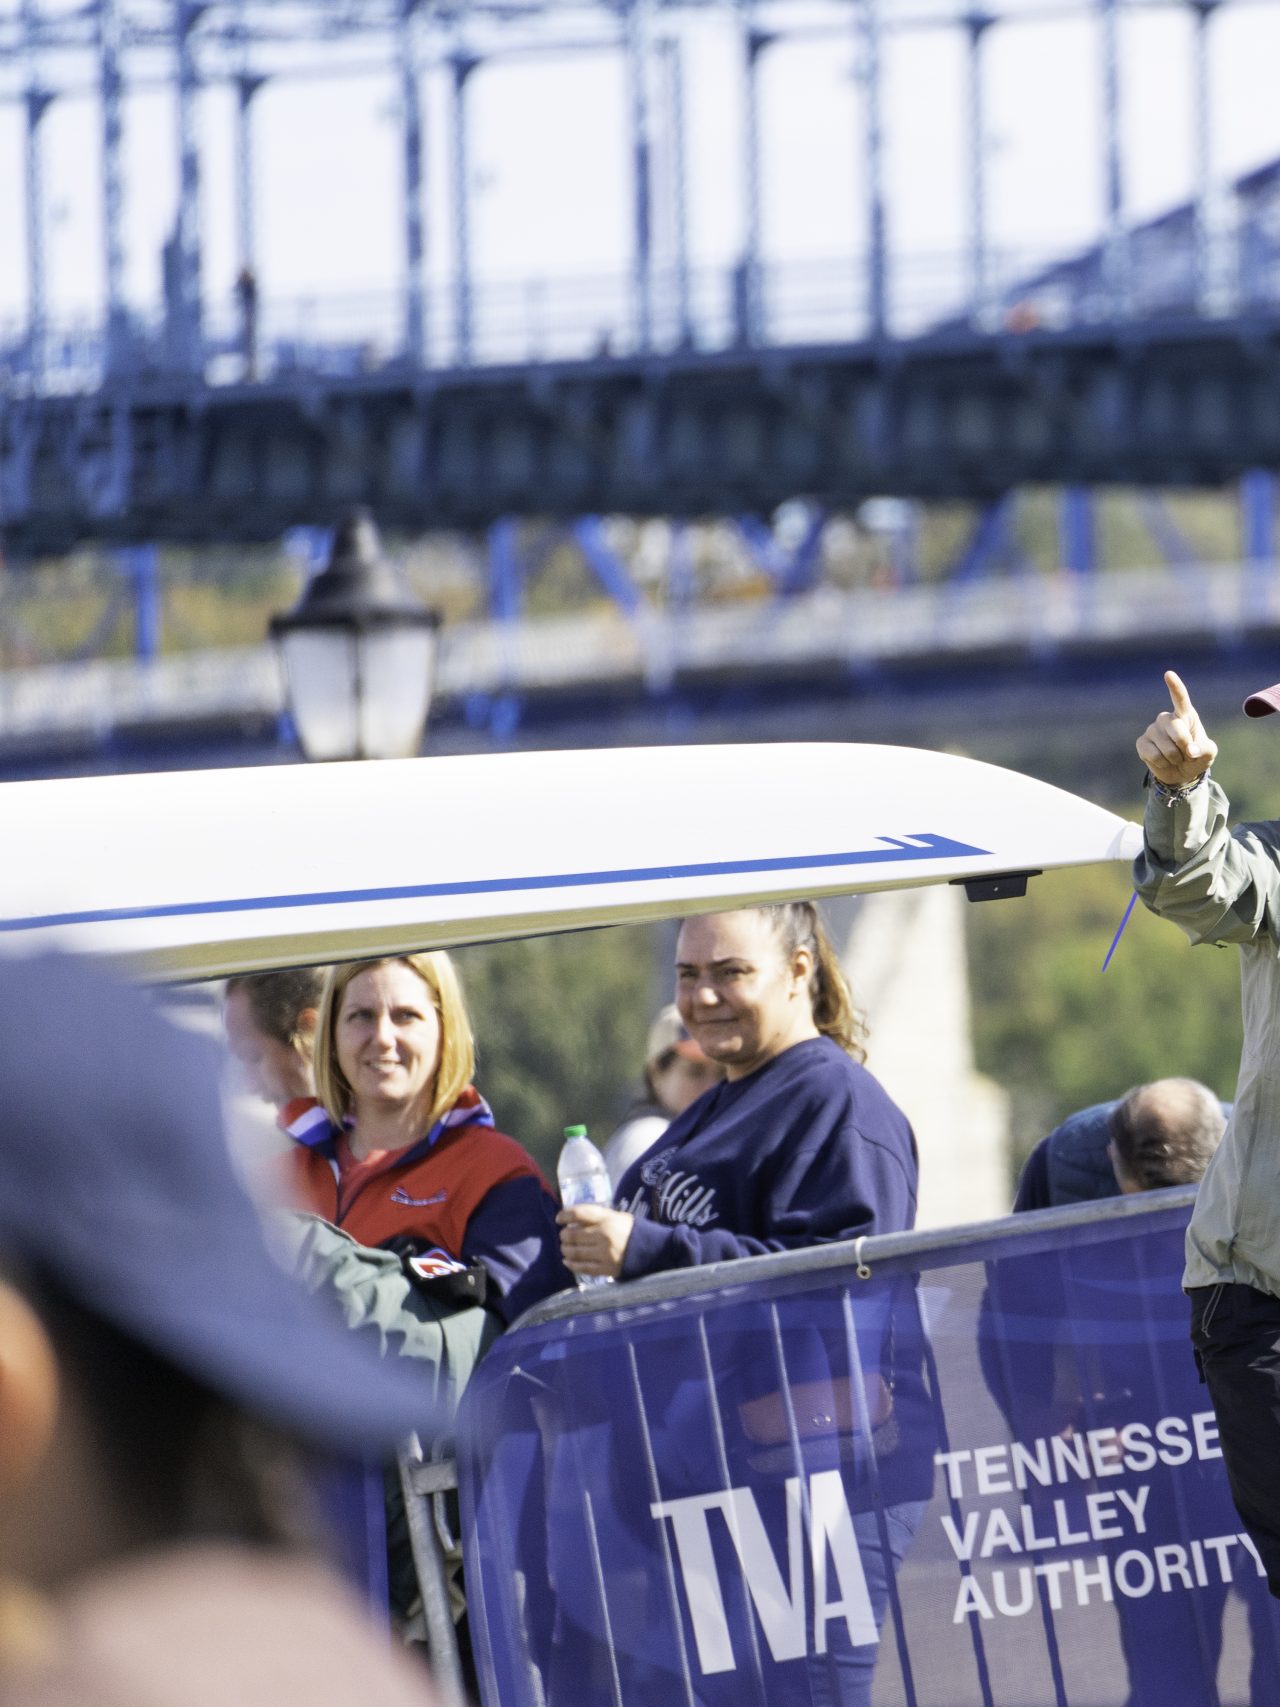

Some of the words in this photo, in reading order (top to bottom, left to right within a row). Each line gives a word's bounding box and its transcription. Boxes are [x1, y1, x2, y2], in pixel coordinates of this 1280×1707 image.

[657, 1170, 720, 1227] Hills
[934, 1411, 1224, 1499] TENNESSE
[941, 1485, 1151, 1562] VALLEY
[650, 1469, 880, 1675] TVA
